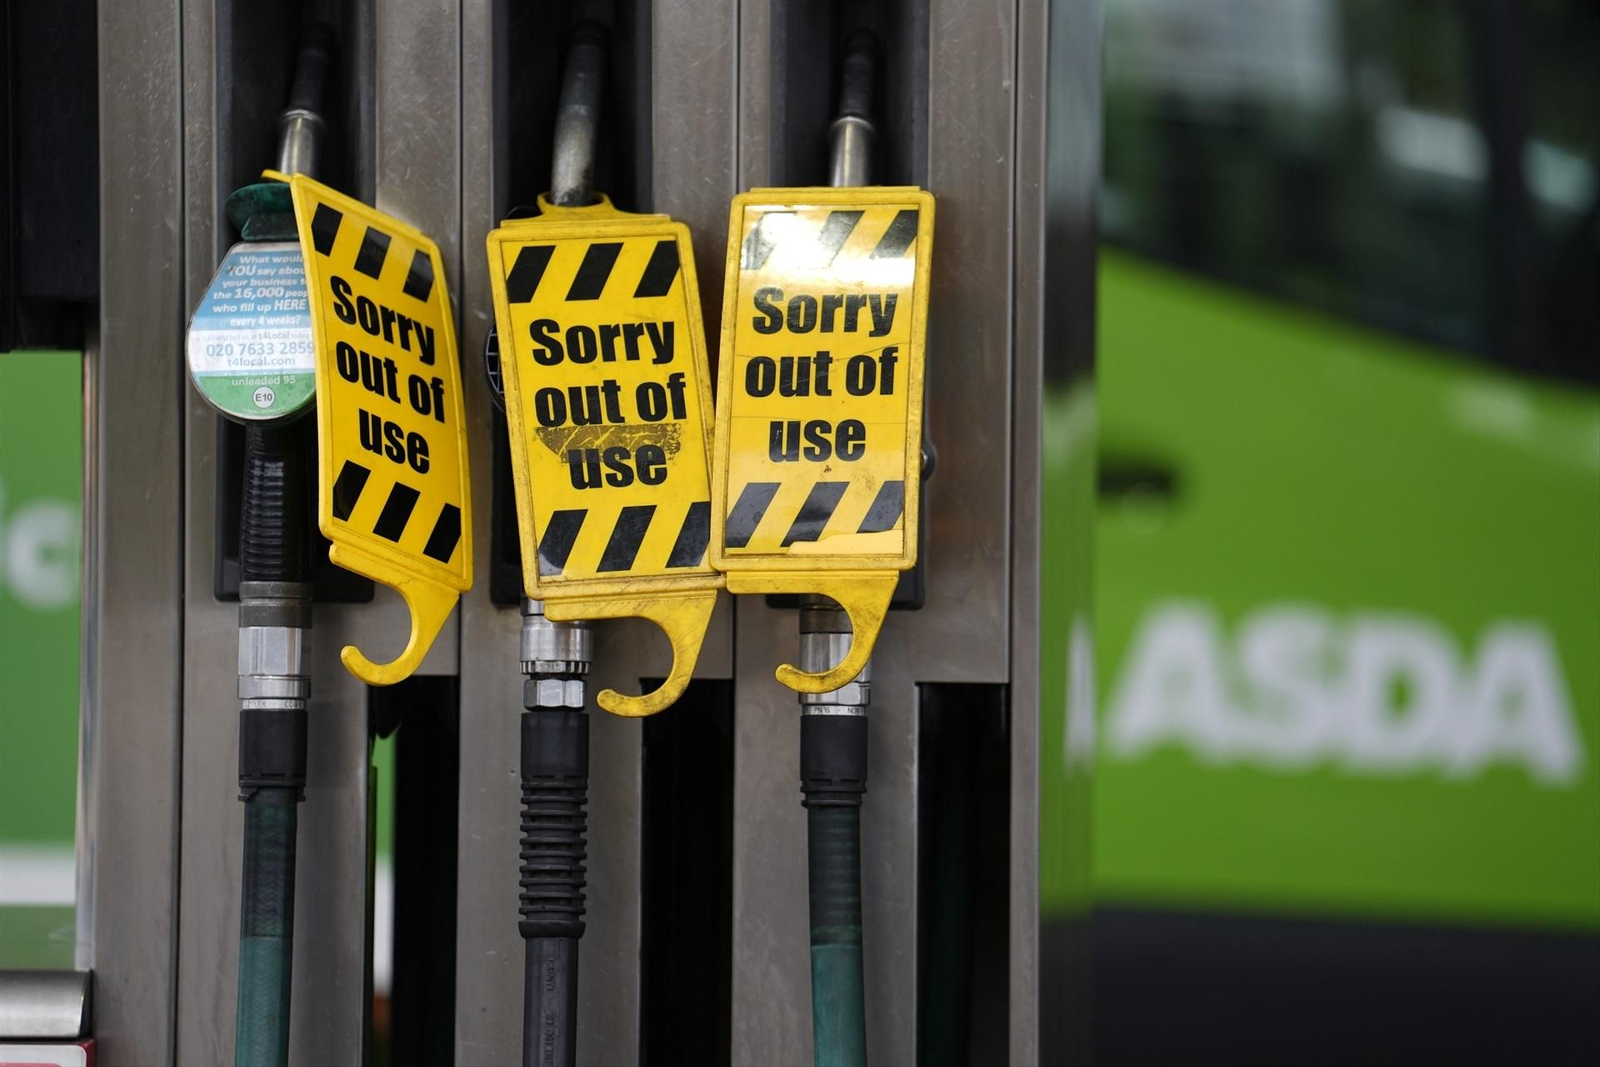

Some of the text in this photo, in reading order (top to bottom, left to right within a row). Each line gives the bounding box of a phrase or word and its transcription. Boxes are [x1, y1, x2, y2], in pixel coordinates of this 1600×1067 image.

[222, 278, 249, 288] your
[250, 277, 297, 287] business
[227, 265, 305, 277] YOU say abou
[213, 288, 309, 301] the 16,000 peop
[239, 303, 254, 312] fill
[257, 304, 271, 313] up
[274, 299, 306, 310] HERE
[752, 287, 898, 338] Sorry
[230, 316, 301, 328] every 4 weeks?
[331, 276, 436, 365] Sorry
[530, 319, 675, 366] Sorry
[206, 341, 314, 357] 020 7633 2859
[227, 356, 296, 367] t4local.com
[232, 375, 296, 386] unleaded 95
[336, 342, 446, 423] out of
[745, 346, 899, 398] out of
[255, 393, 273, 402] E10
[535, 373, 687, 428] out of
[358, 408, 430, 474] use
[769, 418, 866, 462] use
[568, 444, 668, 490] use
[1103, 598, 1583, 788] ASDA
